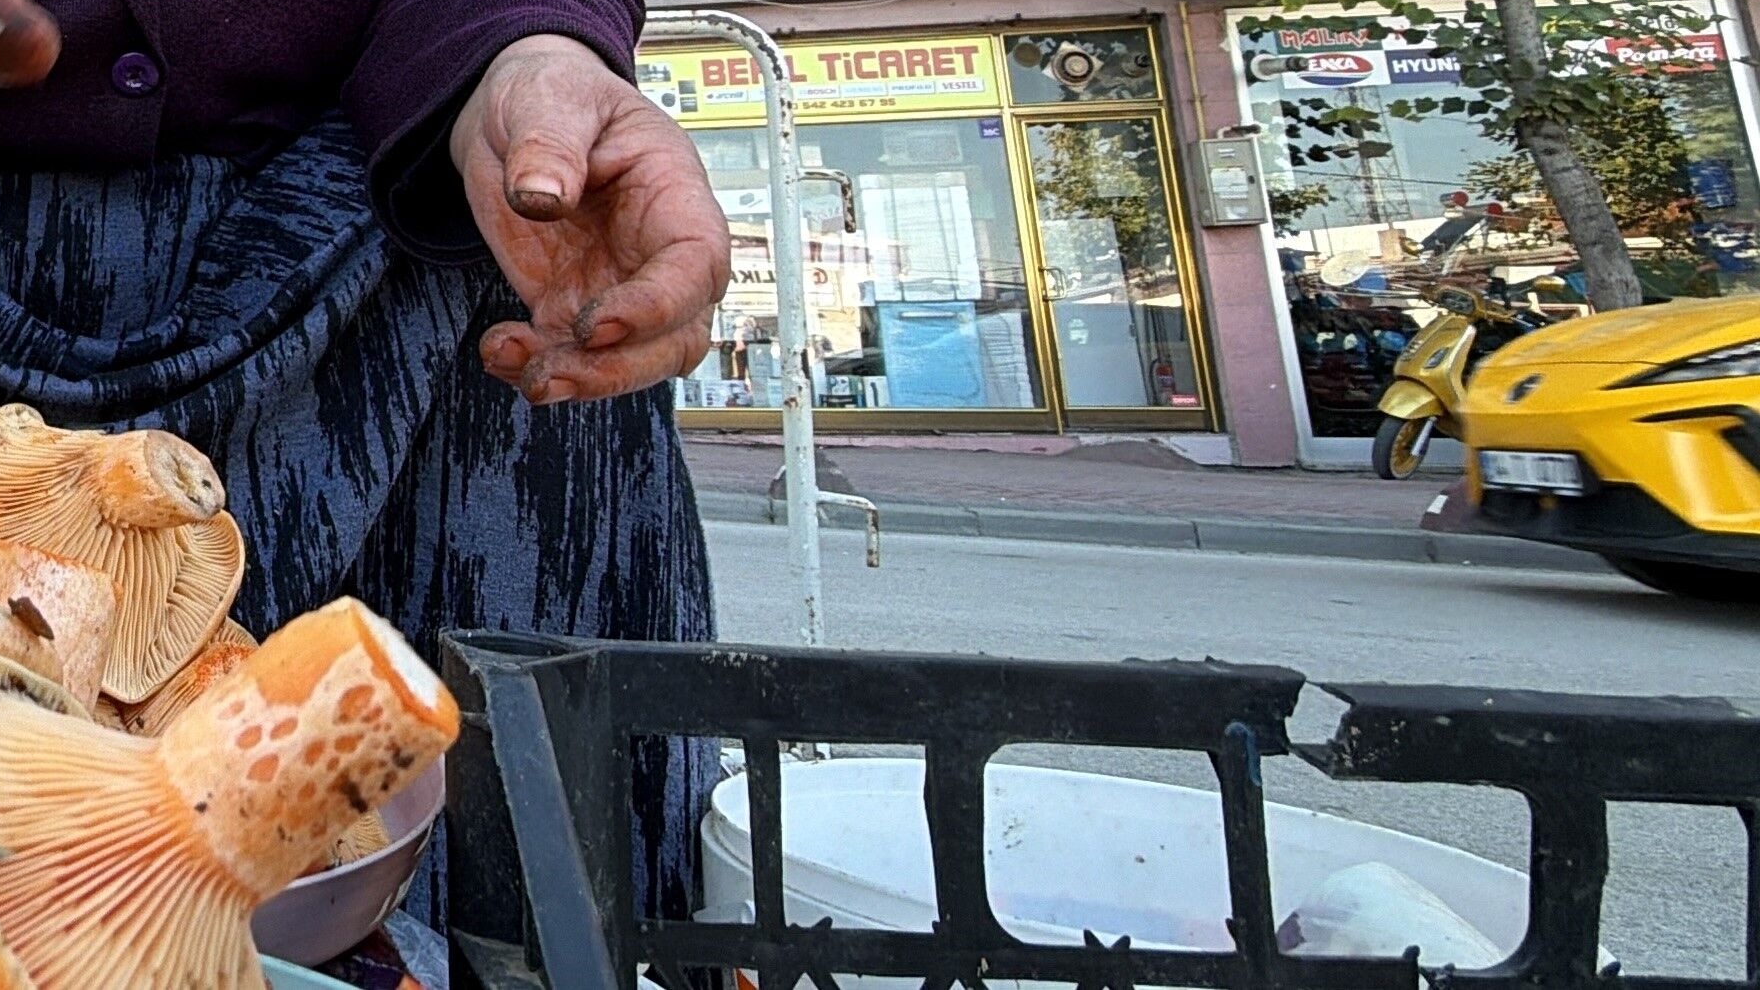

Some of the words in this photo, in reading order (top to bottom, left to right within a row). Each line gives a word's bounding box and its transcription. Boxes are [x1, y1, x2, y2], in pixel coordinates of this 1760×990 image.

[1308, 57, 1360, 72] ENKA
[1392, 58, 1461, 74] HYUN
[942, 81, 978, 90] VESTEL
[807, 88, 837, 96] BOSCH
